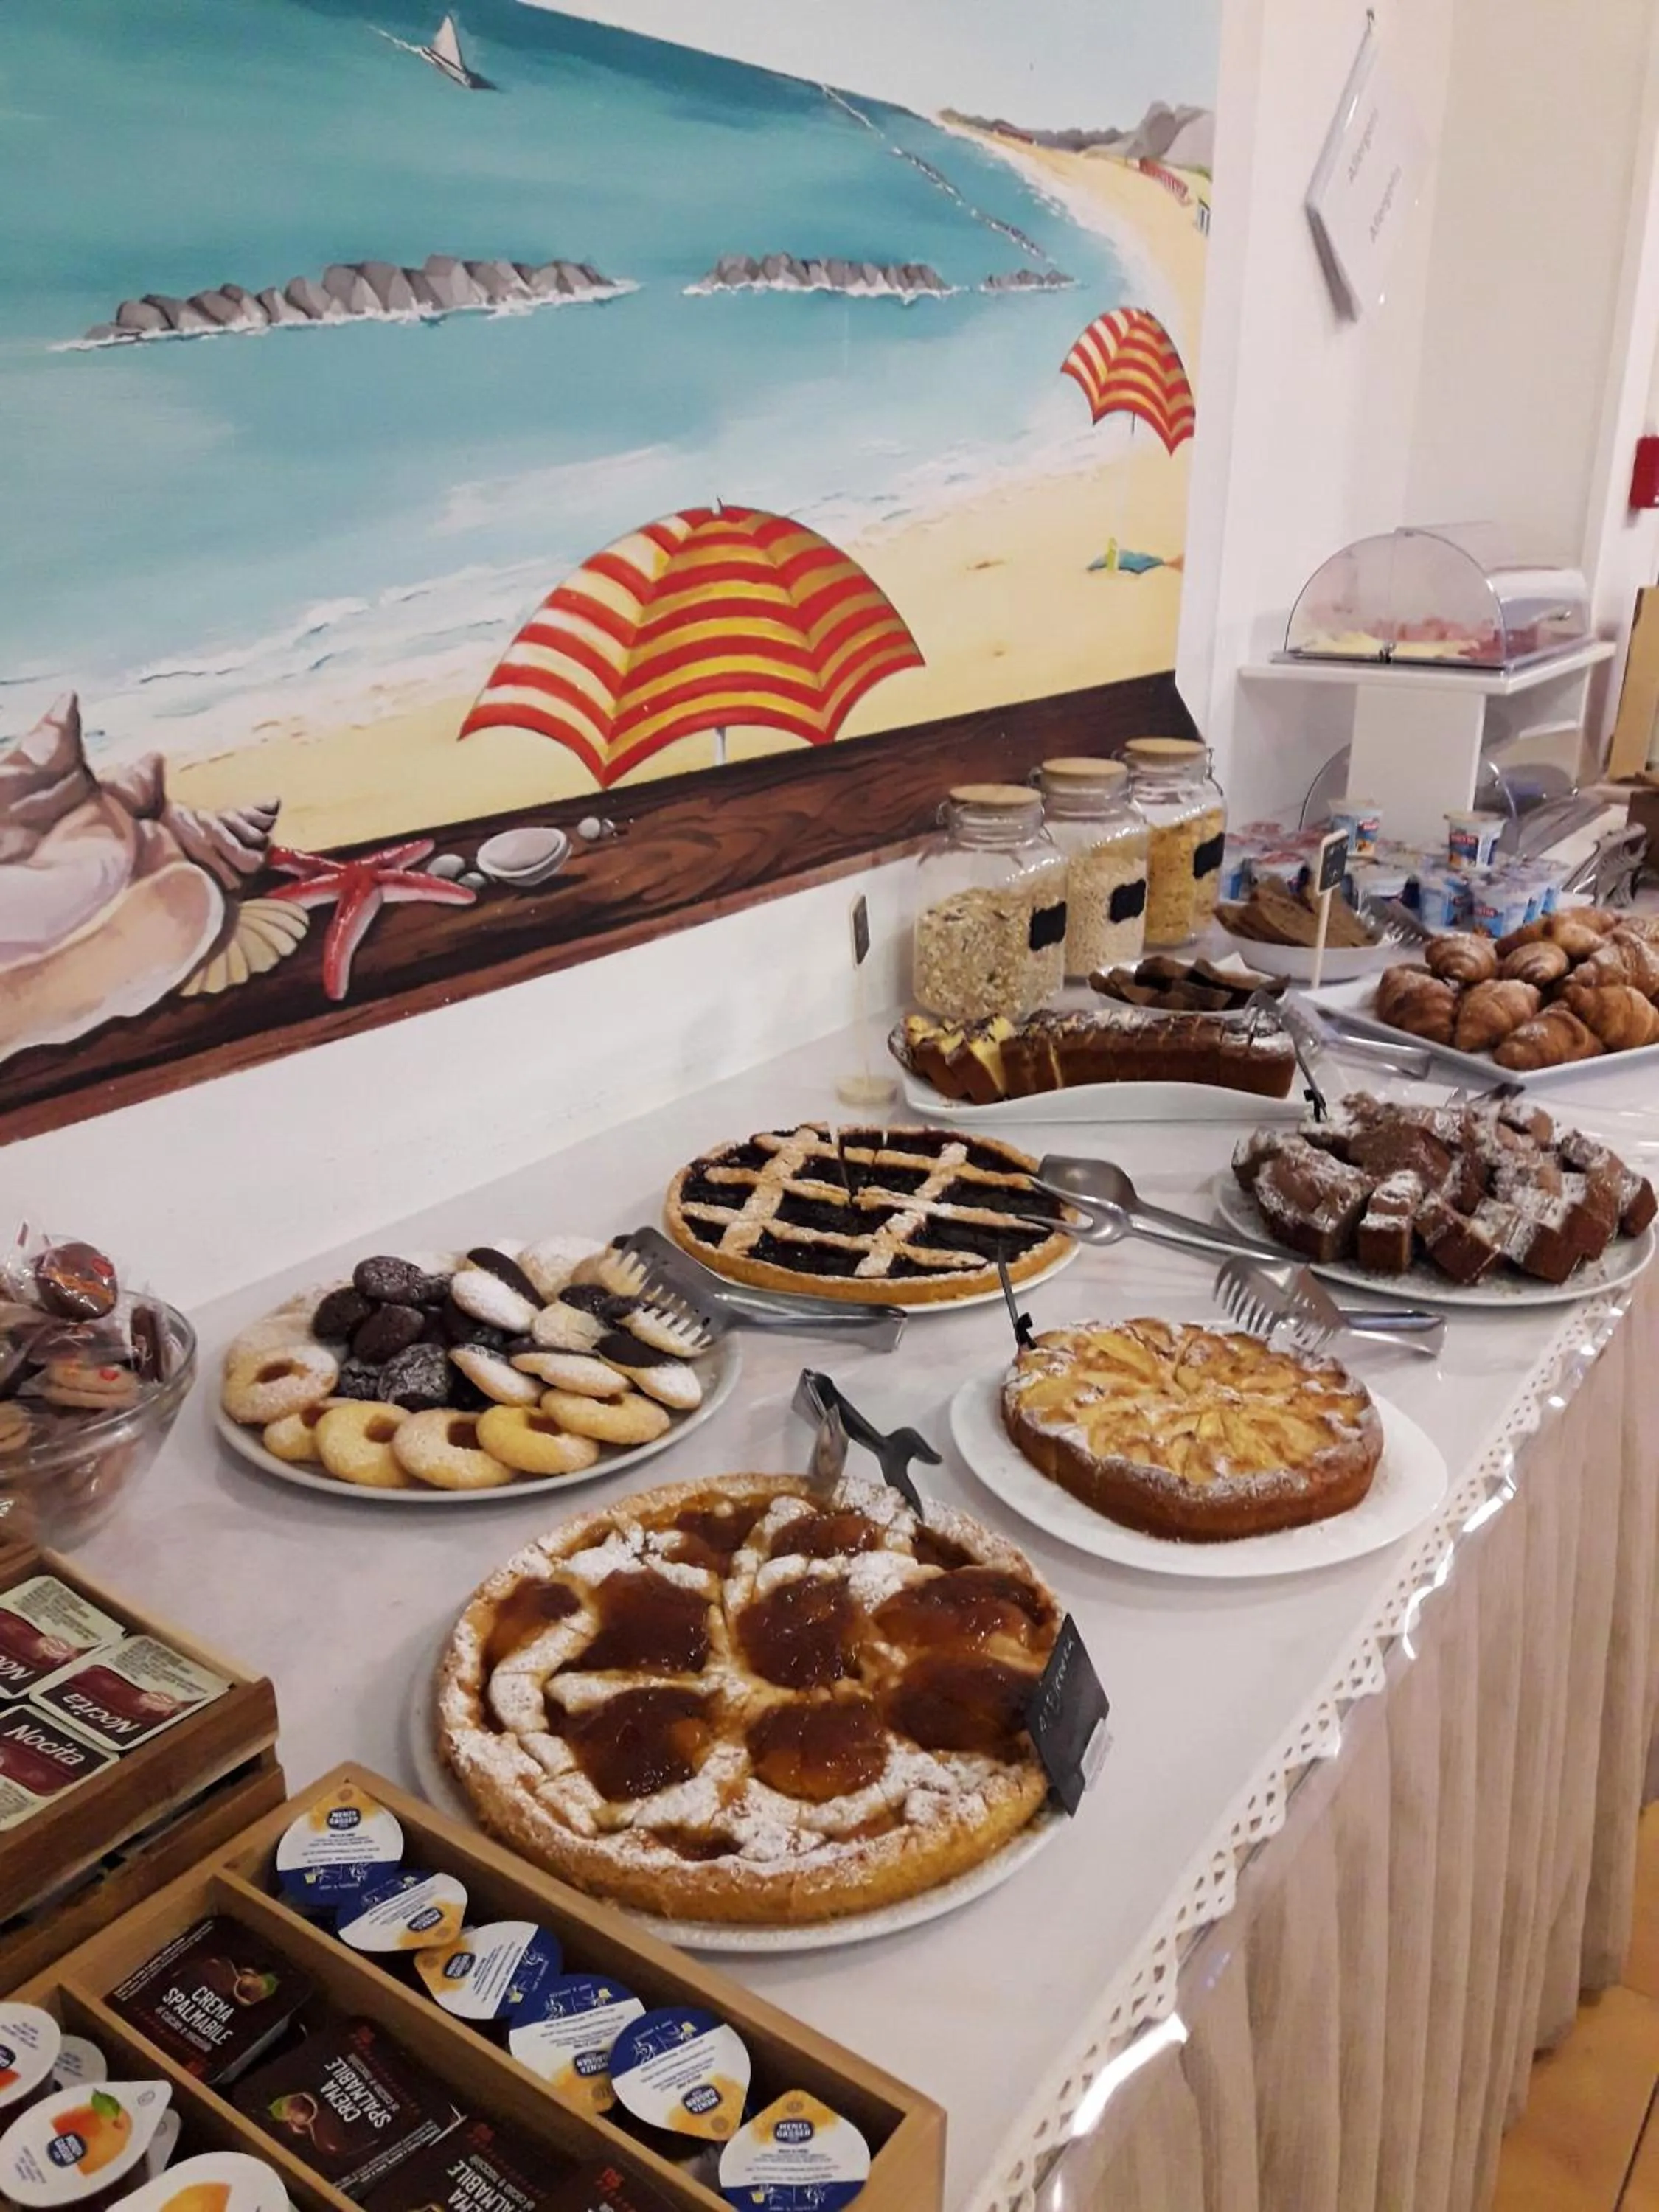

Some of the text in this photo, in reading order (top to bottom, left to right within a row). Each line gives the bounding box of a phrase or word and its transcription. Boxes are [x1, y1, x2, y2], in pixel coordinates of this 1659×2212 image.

[62, 1693, 142, 1733] Nocita
[3, 1725, 86, 1766] Nocita
[162, 1987, 234, 2045] SPALMABILE
[192, 1986, 234, 2024] CREMA
[320, 2079, 361, 2122] CREMA
[324, 2056, 392, 2129] SPALMABILE
[446, 2160, 523, 2212] ALMABILE
